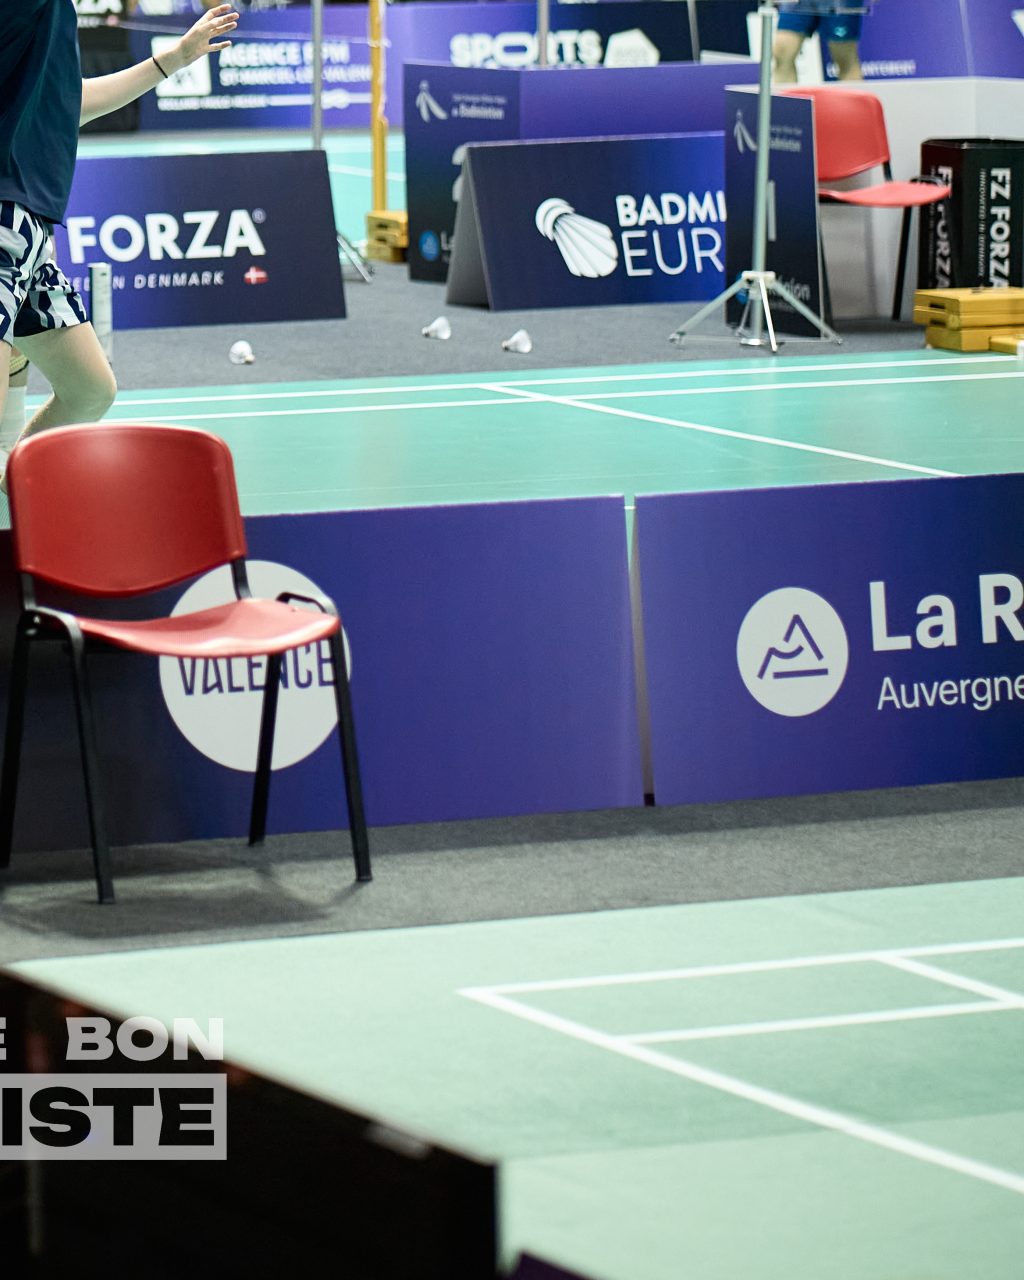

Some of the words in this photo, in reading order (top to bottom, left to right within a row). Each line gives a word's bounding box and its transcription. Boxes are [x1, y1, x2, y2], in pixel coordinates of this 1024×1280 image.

[219, 42, 301, 67] AGENCE
[989, 167, 1012, 200] FZ
[66, 209, 266, 264] FORZA
[134, 270, 225, 289] DENMARK
[869, 580, 958, 652] La
